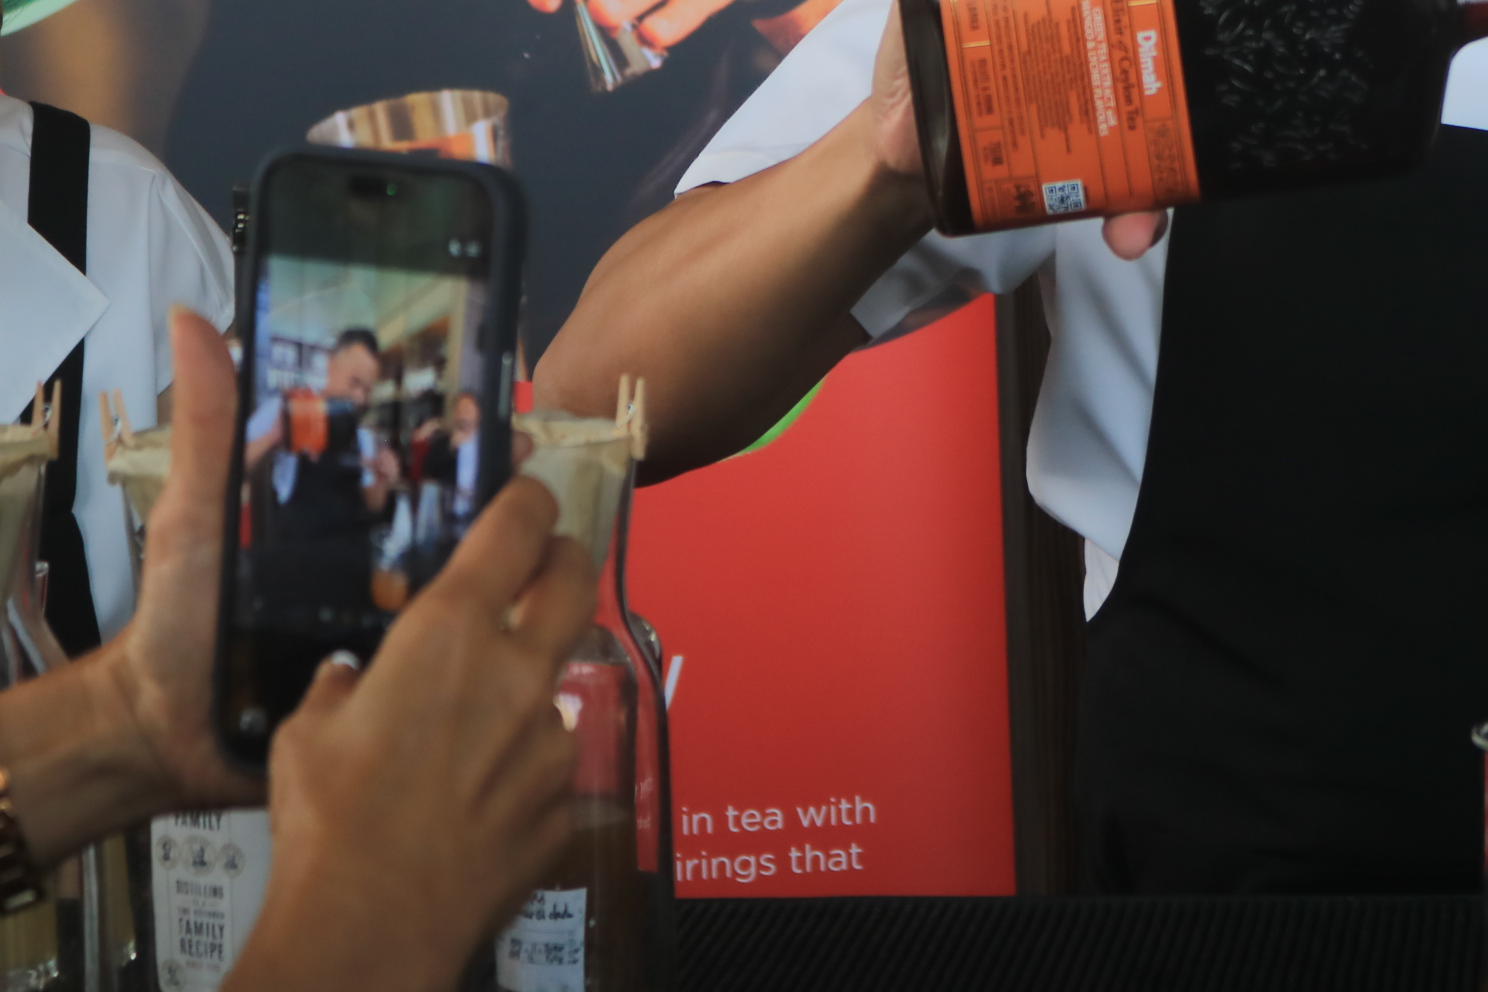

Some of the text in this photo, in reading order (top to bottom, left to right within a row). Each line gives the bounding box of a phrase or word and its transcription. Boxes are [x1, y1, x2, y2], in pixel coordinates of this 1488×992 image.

[1091, 7, 1105, 41] GREEN
[1096, 43, 1108, 63] TEA
[1136, 29, 1164, 96] Dilmah
[1099, 63, 1115, 108] EXTRACT
[1113, 56, 1138, 107] Ceylon
[1125, 108, 1141, 132] Tea
[681, 795, 877, 836] in tea with
[675, 842, 863, 884] irings that
[178, 917, 225, 941] FAMILY
[180, 938, 224, 962] RECIPE
